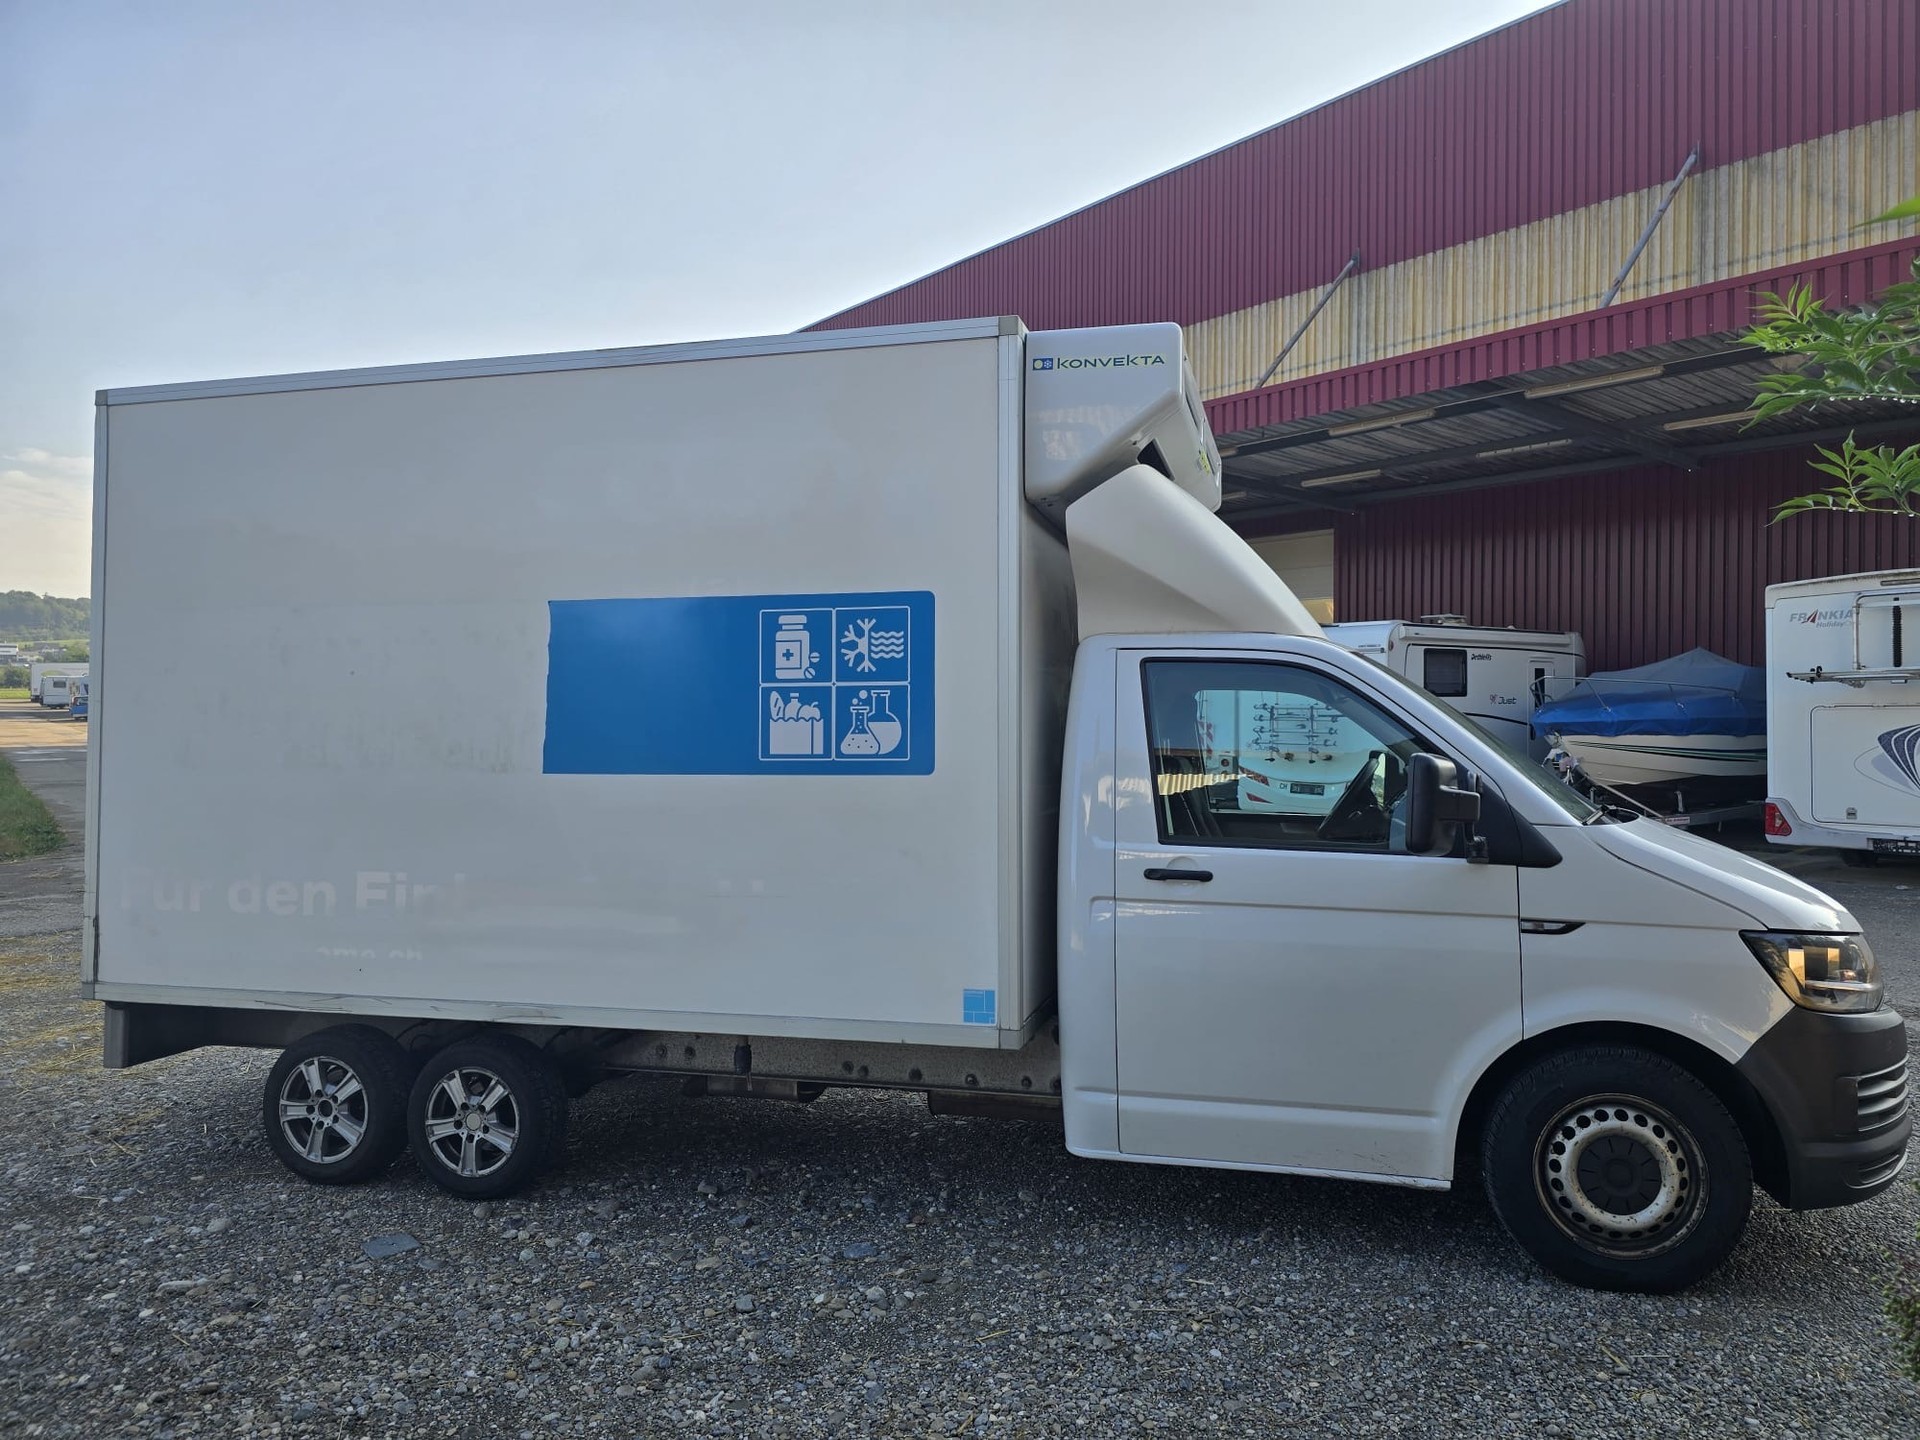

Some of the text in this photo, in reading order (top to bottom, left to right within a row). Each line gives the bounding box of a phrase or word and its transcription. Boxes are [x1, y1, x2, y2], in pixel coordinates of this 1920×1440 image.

[1057, 354, 1165, 369] KONVEKTA
[1789, 609, 1853, 624] FRANKIA
[1498, 696, 1517, 705] Just
[227, 871, 338, 917] den
